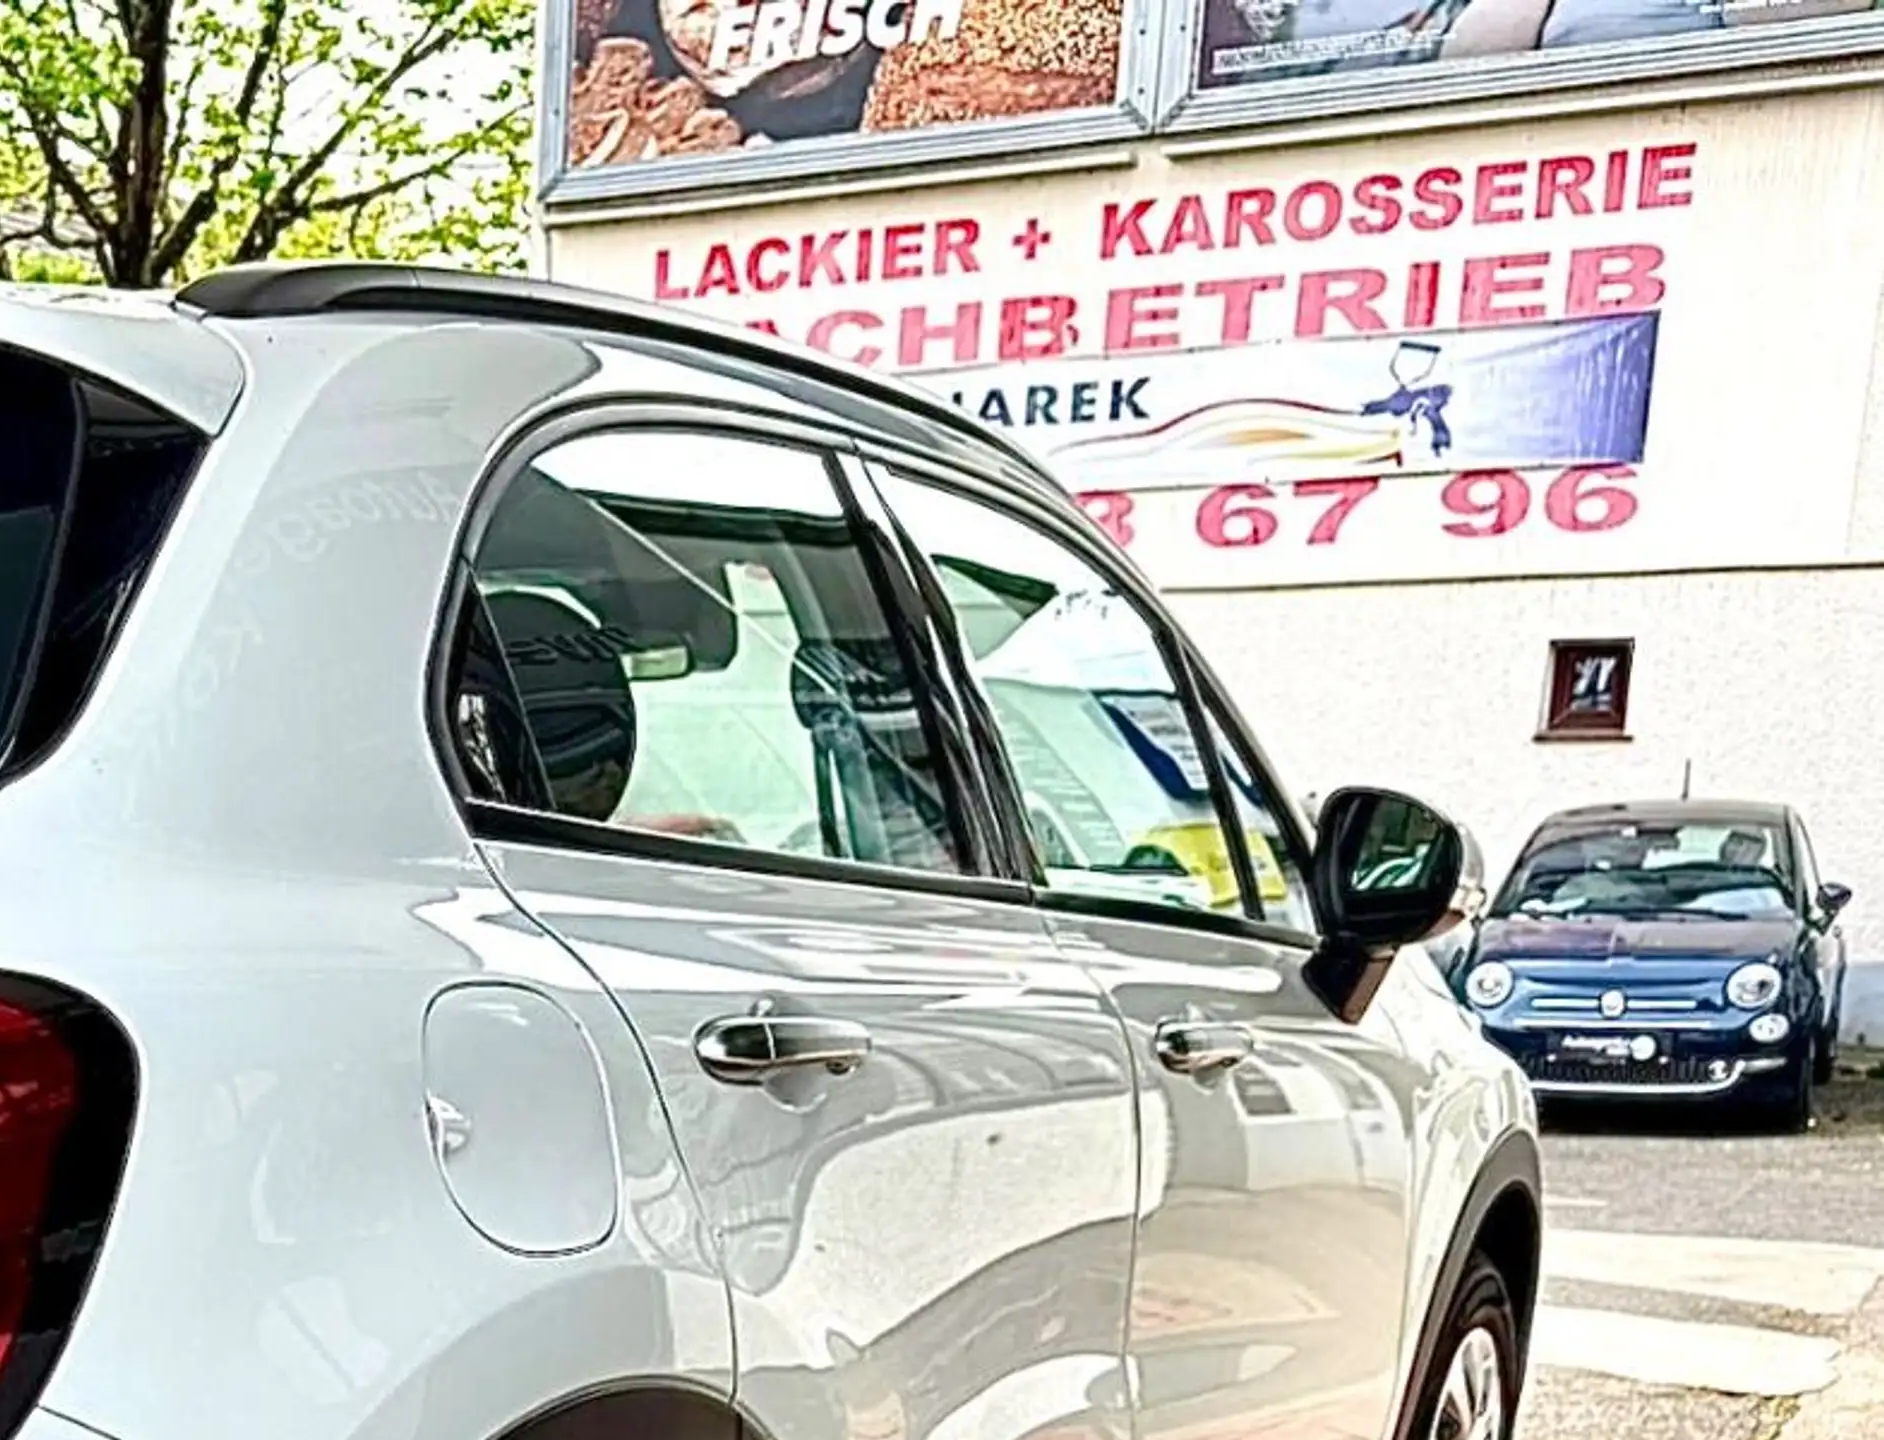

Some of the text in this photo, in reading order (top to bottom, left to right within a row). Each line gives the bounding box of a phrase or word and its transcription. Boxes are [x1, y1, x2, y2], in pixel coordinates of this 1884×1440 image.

[708, 0, 965, 72] FRISCH
[655, 217, 979, 302] LACKIER
[1099, 143, 1698, 261] KAROSSERIE
[746, 243, 1667, 368] CHBETRIEB
[952, 376, 1151, 427] AREK
[1196, 475, 1380, 548] 67
[1440, 462, 1639, 538] 96
